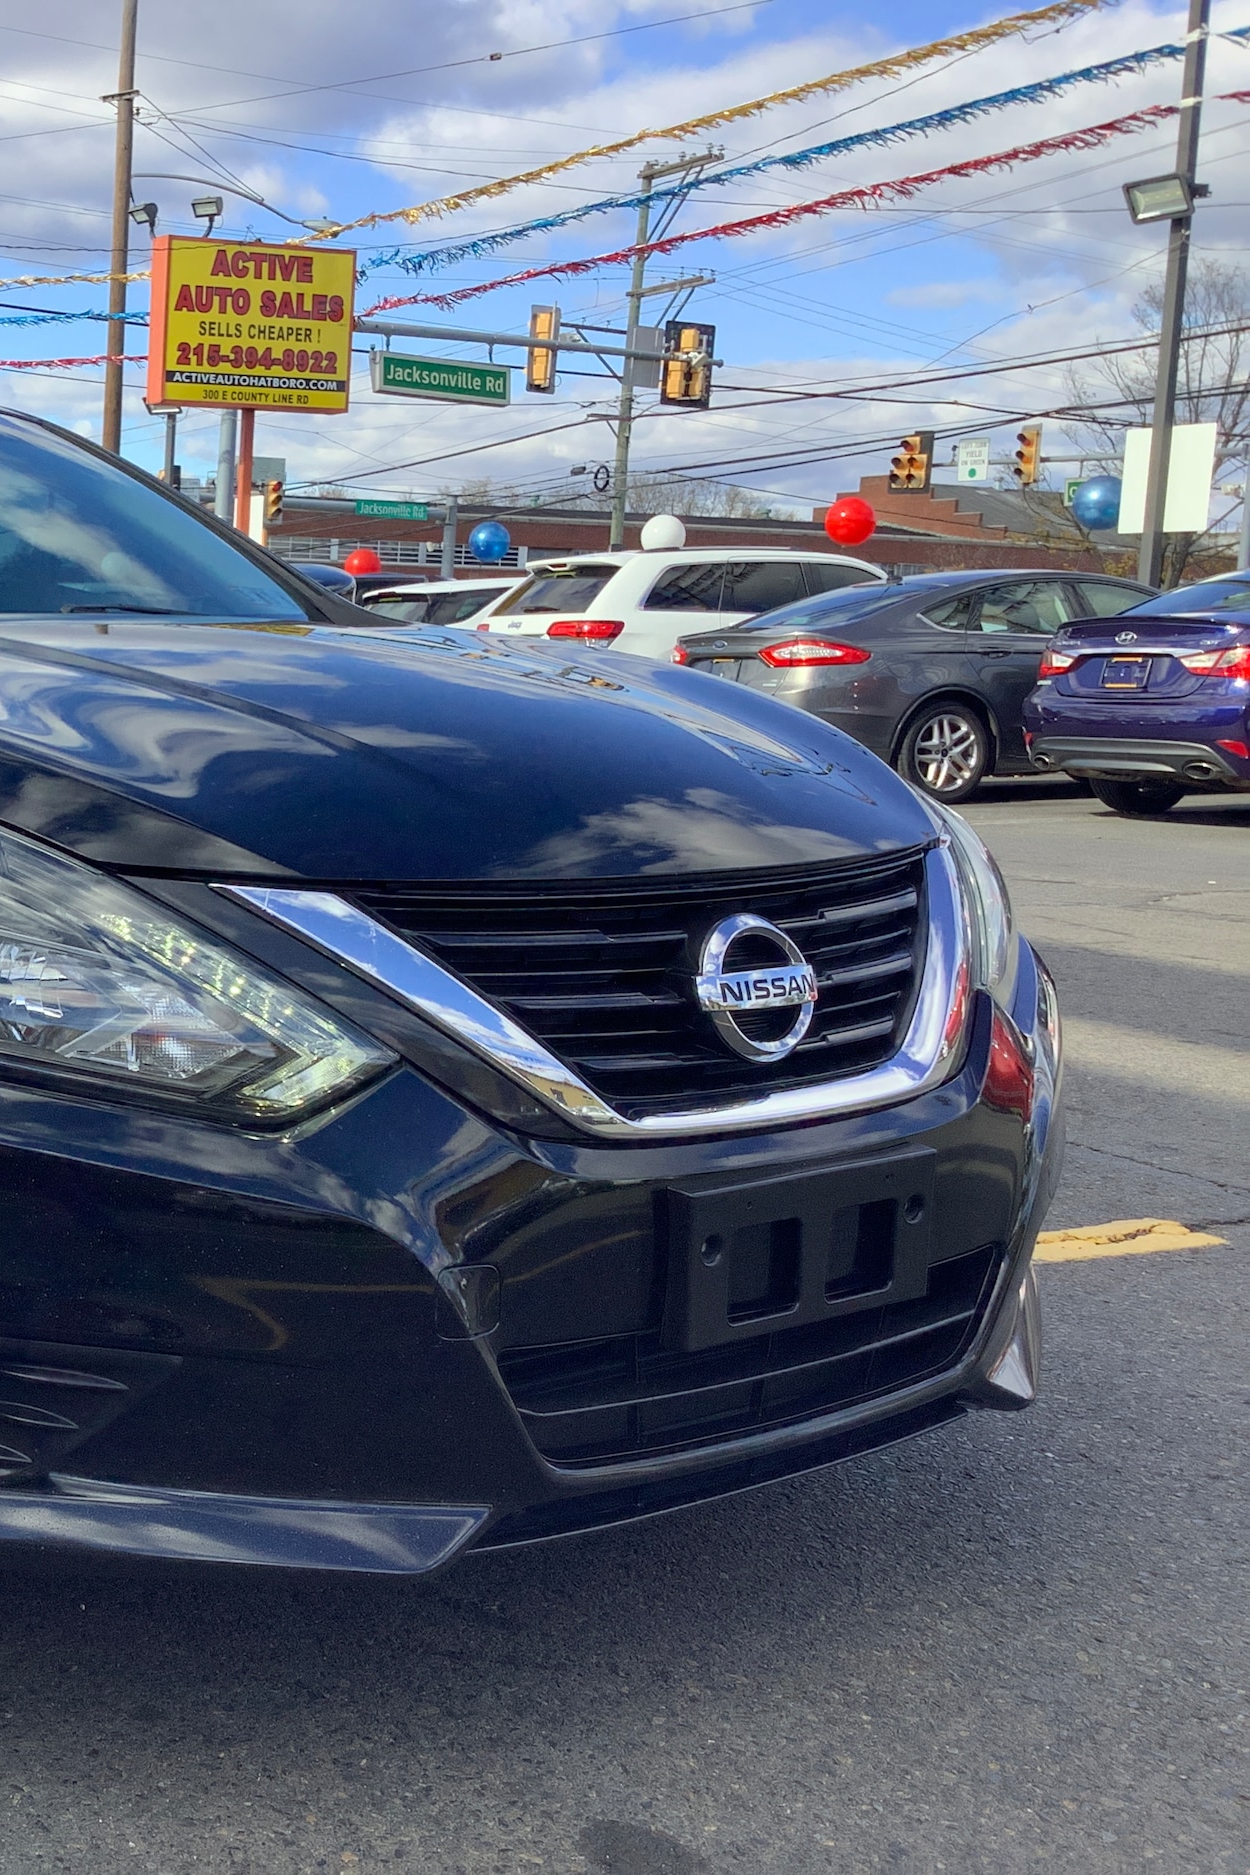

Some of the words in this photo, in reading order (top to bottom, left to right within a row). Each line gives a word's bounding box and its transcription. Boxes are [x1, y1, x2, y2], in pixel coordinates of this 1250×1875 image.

[210, 249, 313, 283] ACTIVE
[174, 284, 250, 316] AUTO
[260, 290, 344, 323] SALES
[198, 321, 242, 339] SELLS
[248, 323, 313, 343] CHEAPER
[176, 341, 337, 375] 215-394-8922
[172, 371, 338, 391] ACTIVEAUTOHATBORO.COM
[386, 364, 482, 390] Jacksonville
[485, 376, 504, 393] Rd
[202, 389, 219, 400] 300
[222, 390, 228, 400] E
[230, 391, 269, 403] COUNTY
[272, 393, 294, 404] LINE
[297, 394, 309, 405] RD
[359, 502, 411, 518] Jacksonville
[412, 505, 424, 518] Rd
[719, 972, 816, 1003] NISSAN
